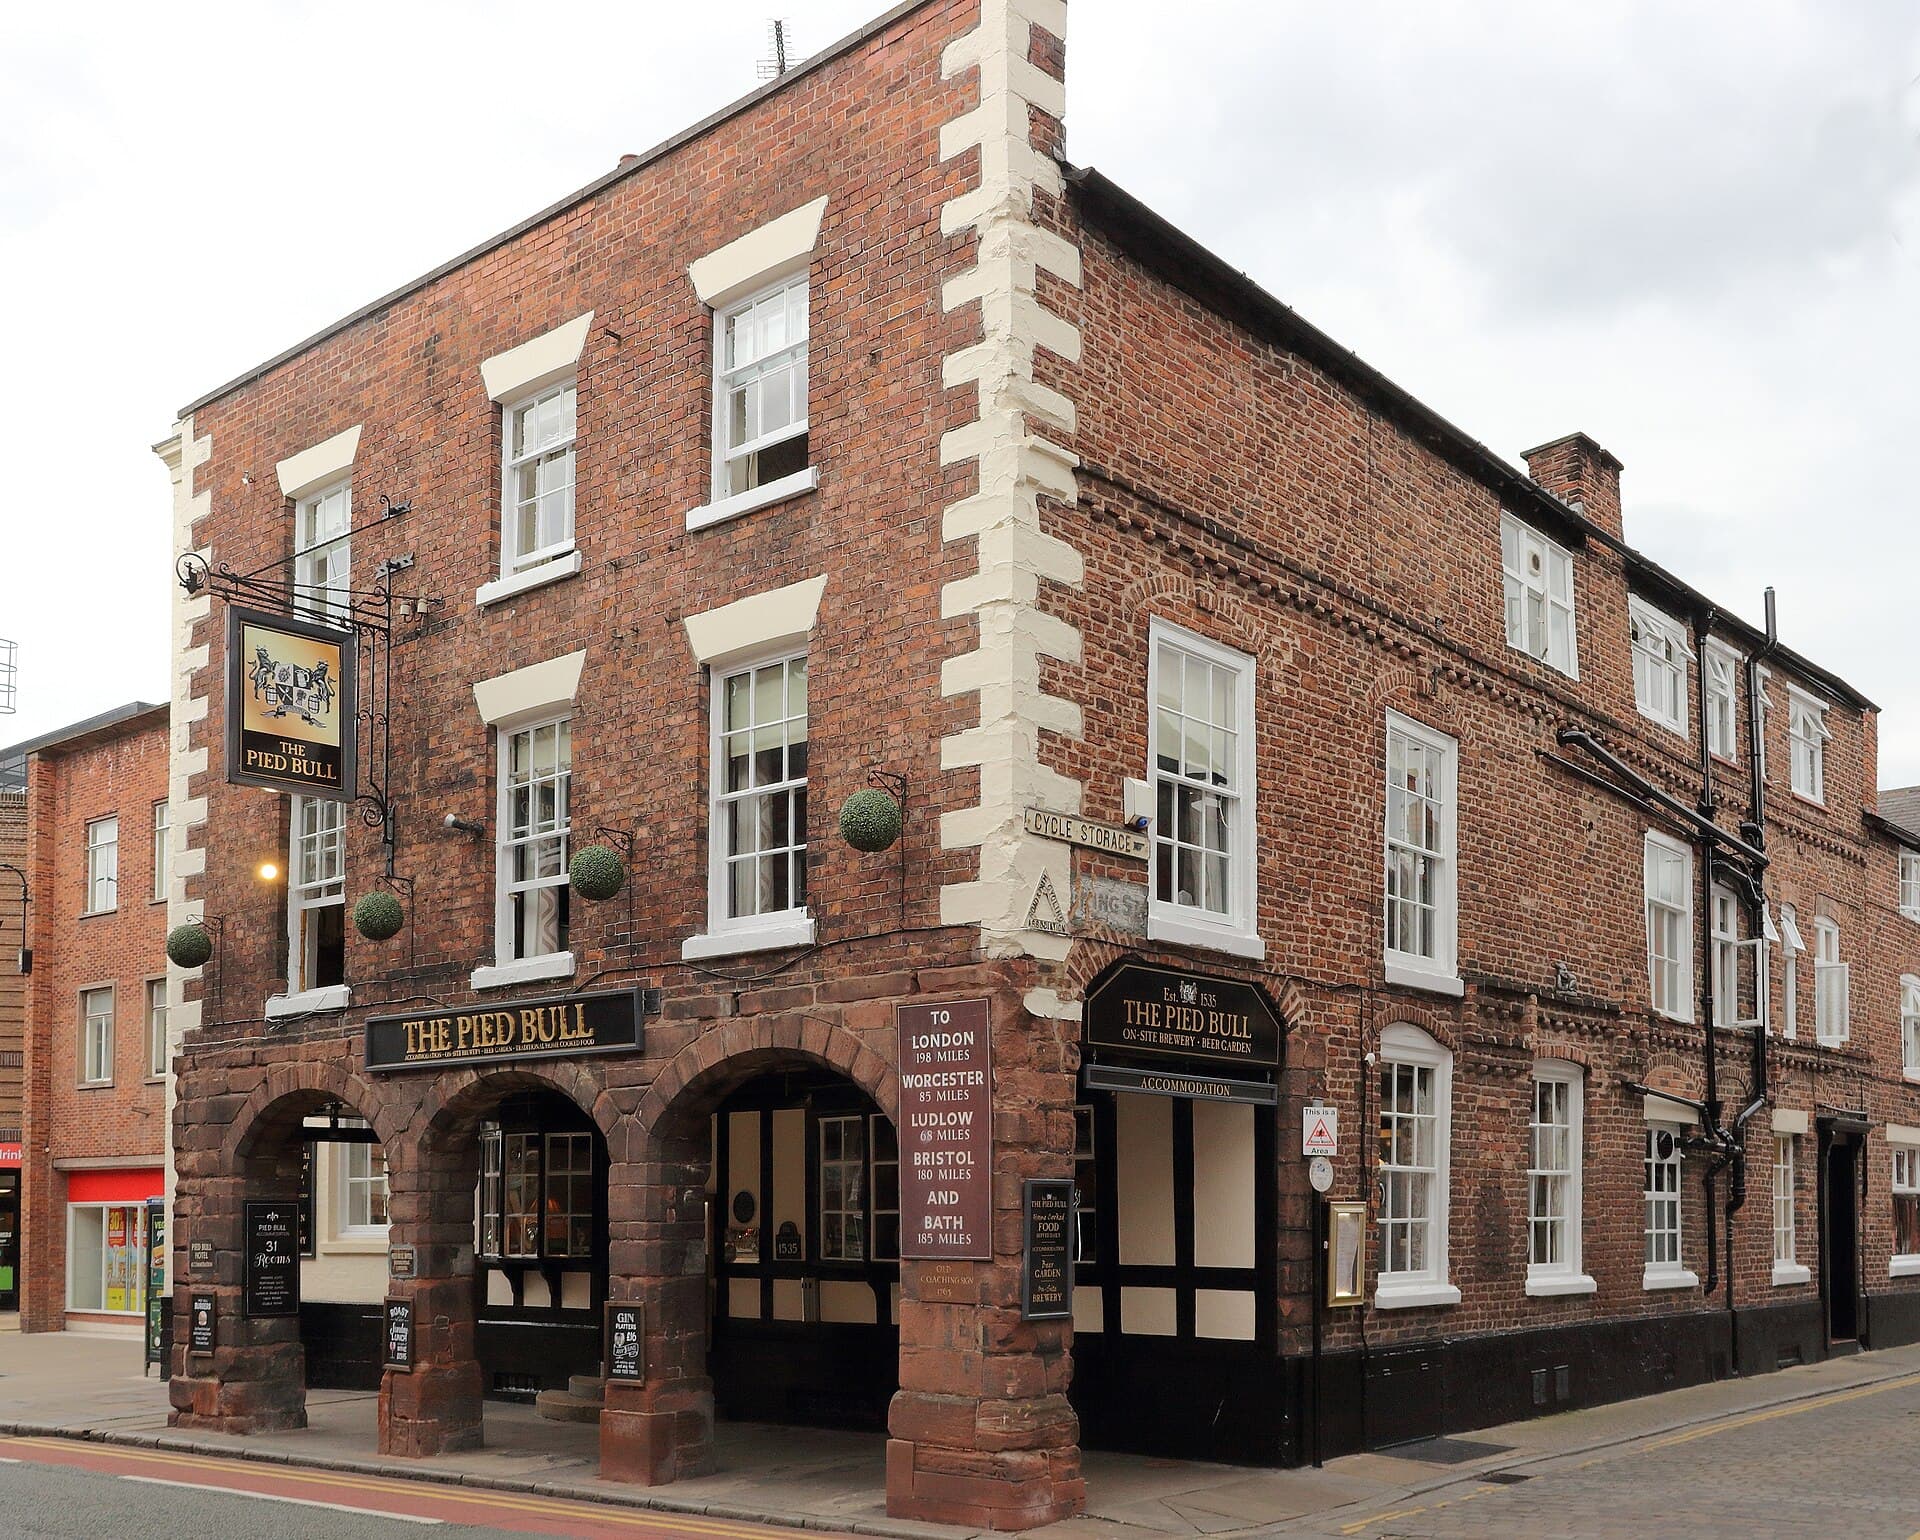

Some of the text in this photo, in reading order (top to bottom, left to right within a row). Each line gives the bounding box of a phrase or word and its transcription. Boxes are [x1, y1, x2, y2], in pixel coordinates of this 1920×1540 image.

[279, 741, 306, 757] THE
[246, 749, 337, 780] PIED BULL
[1034, 813, 1131, 853] CYCLE STORAGE
[1163, 987, 1217, 1008] Est. 1535
[930, 1010, 950, 1025] TO
[1123, 999, 1252, 1039] THE PIED BULL
[402, 1003, 595, 1054] THE PIED BULL
[912, 1031, 974, 1049] LONDON
[1122, 1027, 1252, 1054] ON-SITE BREWERY BEER GARDEN
[916, 1049, 970, 1064] 198 MILES
[902, 1070, 984, 1089] WORCESTER
[1140, 1076, 1231, 1097] ACCOMMODATION
[919, 1089, 969, 1102] 85 MILES
[911, 1111, 973, 1127] LUDLOW
[920, 1129, 970, 1142] 68 MILES
[913, 1151, 975, 1166] BRISTOL
[917, 1168, 971, 1181] 180 MILES
[926, 1190, 959, 1205] AND
[259, 1224, 287, 1232] PIED BULL
[924, 1215, 963, 1230] BATH
[1038, 1222, 1060, 1231] FOOD
[265, 1240, 278, 1253] 31
[918, 1233, 972, 1245] 185 MILES
[778, 1243, 798, 1255] 1535
[254, 1252, 291, 1269] Rooms
[936, 1264, 952, 1273] OLD
[1034, 1268, 1061, 1279] GARDEN
[920, 1275, 959, 1285] COACHING
[1032, 1293, 1062, 1303] BREWERY
[389, 1306, 409, 1318] ROAST
[616, 1312, 635, 1324] GIN
